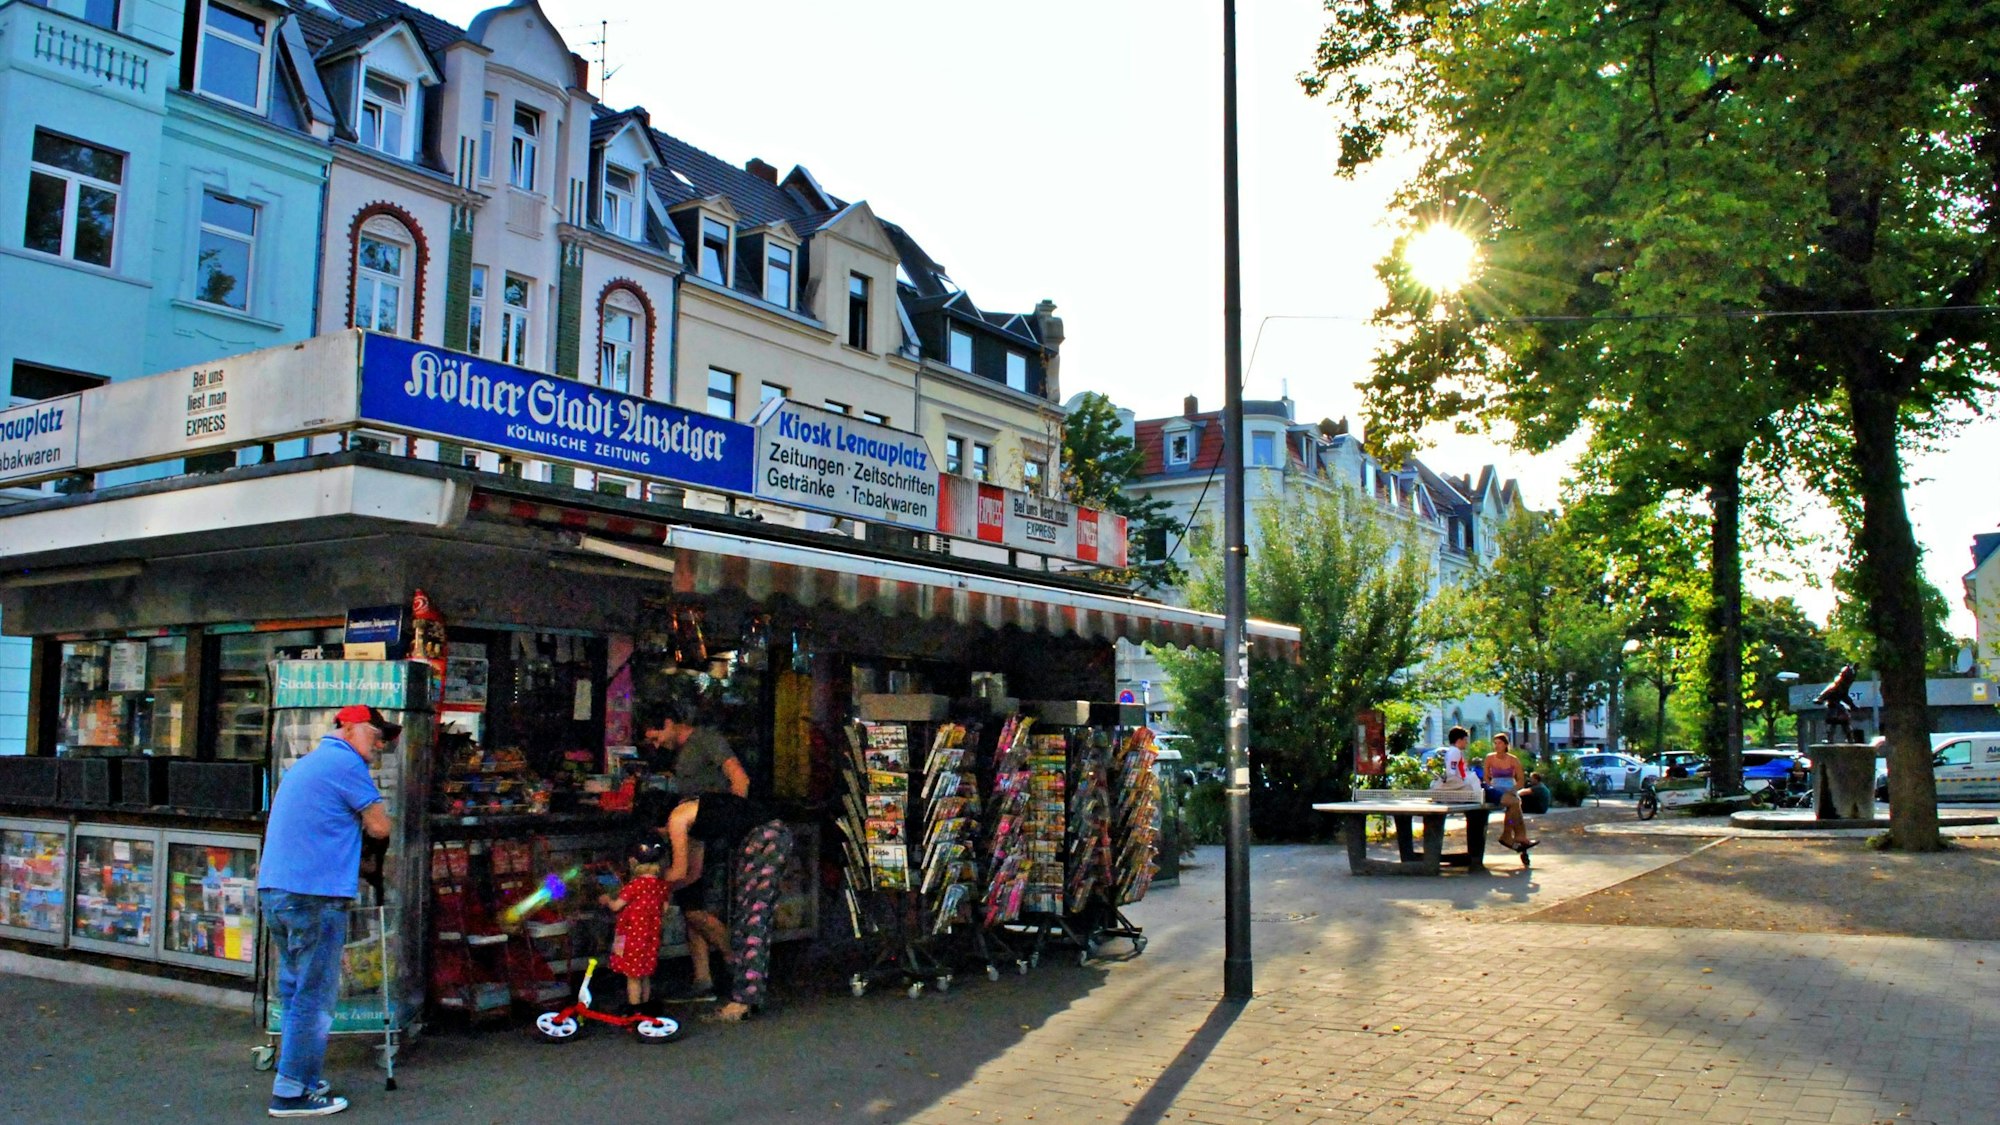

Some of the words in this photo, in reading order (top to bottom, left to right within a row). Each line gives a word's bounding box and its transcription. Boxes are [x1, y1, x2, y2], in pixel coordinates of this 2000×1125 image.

[193, 370, 207, 388] Bei
[208, 369, 224, 384] uns
[187, 393, 206, 411] liest
[208, 391, 227, 407] man
[404, 350, 526, 418] Kölner
[527, 379, 727, 462] Stadt-Anzeiger
[186, 414, 226, 437] EXPRESS
[506, 423, 587, 453] KÖLNISCHE
[594, 442, 651, 466] ZEITUNG
[779, 411, 832, 448] Kiosk
[836, 425, 928, 472] Lenauplatz
[769, 442, 844, 476] Zeitungen
[853, 462, 936, 497] Zeitschriften
[767, 467, 836, 499] Getränke
[852, 485, 928, 518] Tabakwaren
[1014, 498, 1026, 513] Bei
[1027, 504, 1038, 516] uns
[1040, 502, 1054, 520] liest
[1055, 510, 1069, 523] man
[1026, 521, 1057, 540] EXPRESS
[301, 645, 324, 660] art
